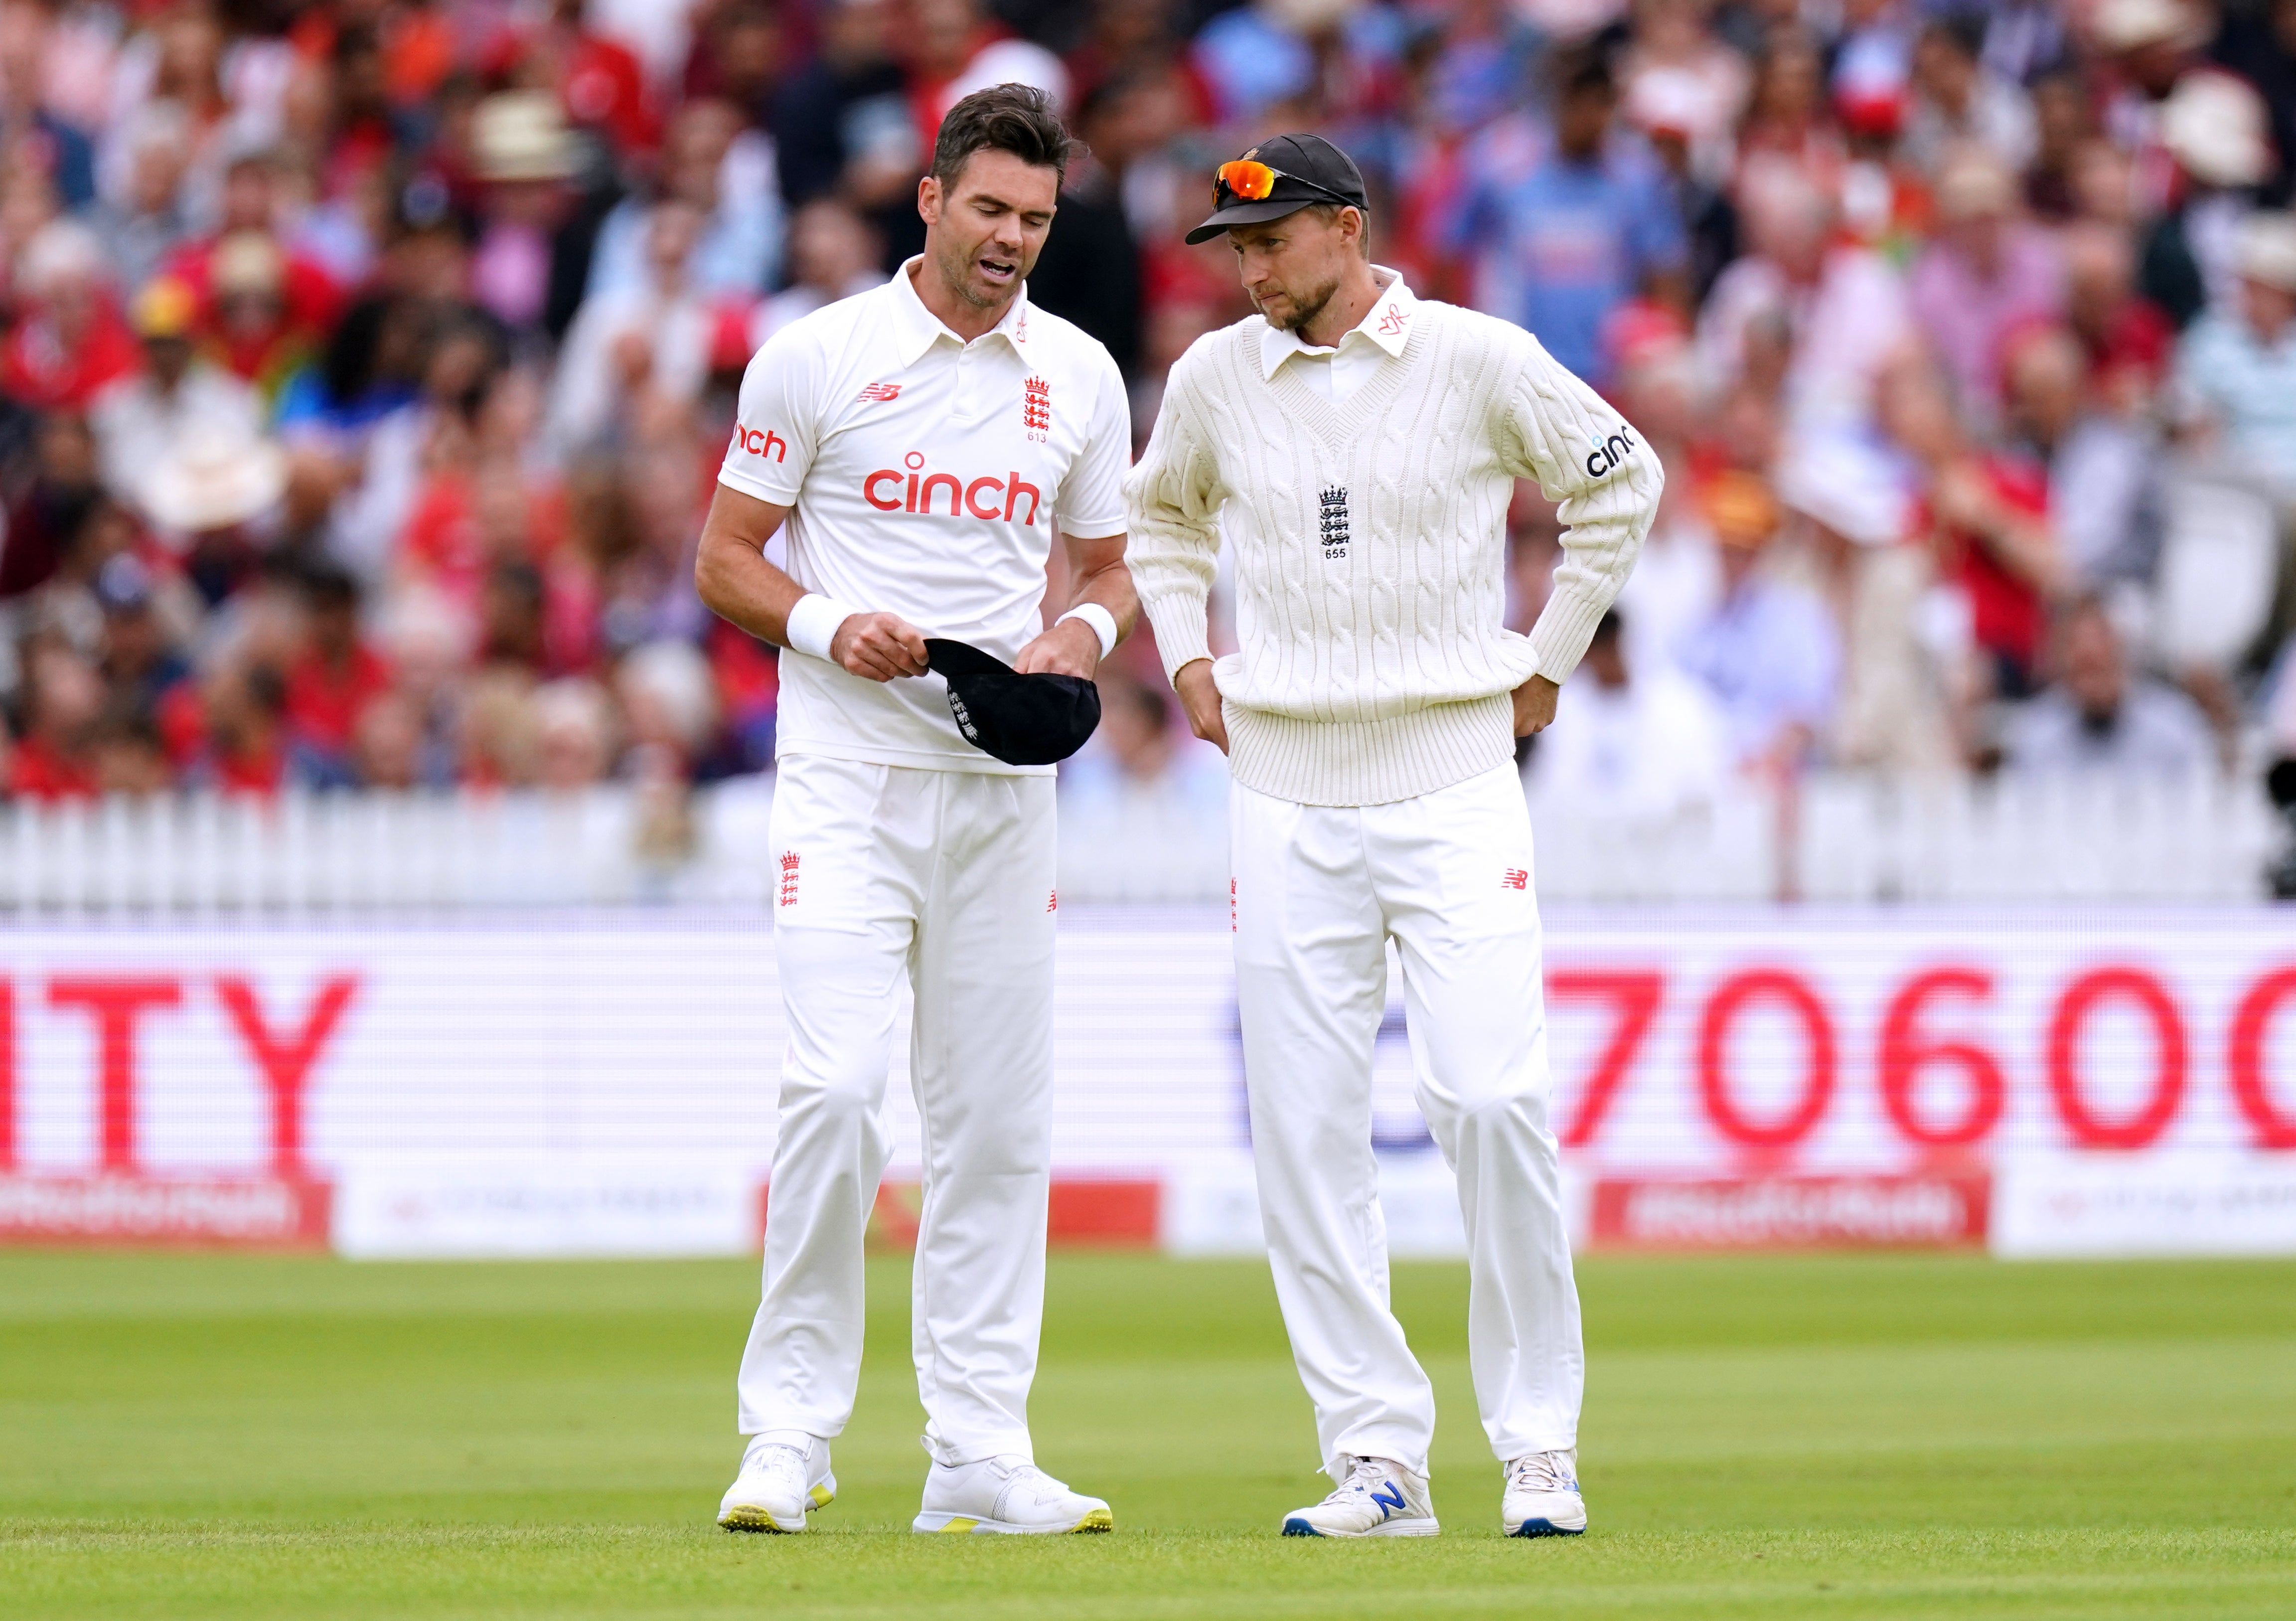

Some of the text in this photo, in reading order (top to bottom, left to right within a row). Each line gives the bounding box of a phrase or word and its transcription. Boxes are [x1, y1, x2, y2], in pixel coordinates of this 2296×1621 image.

[1028, 432, 1046, 443] 613
[864, 451, 1040, 526] cinch
[1326, 548, 1346, 559] 655
